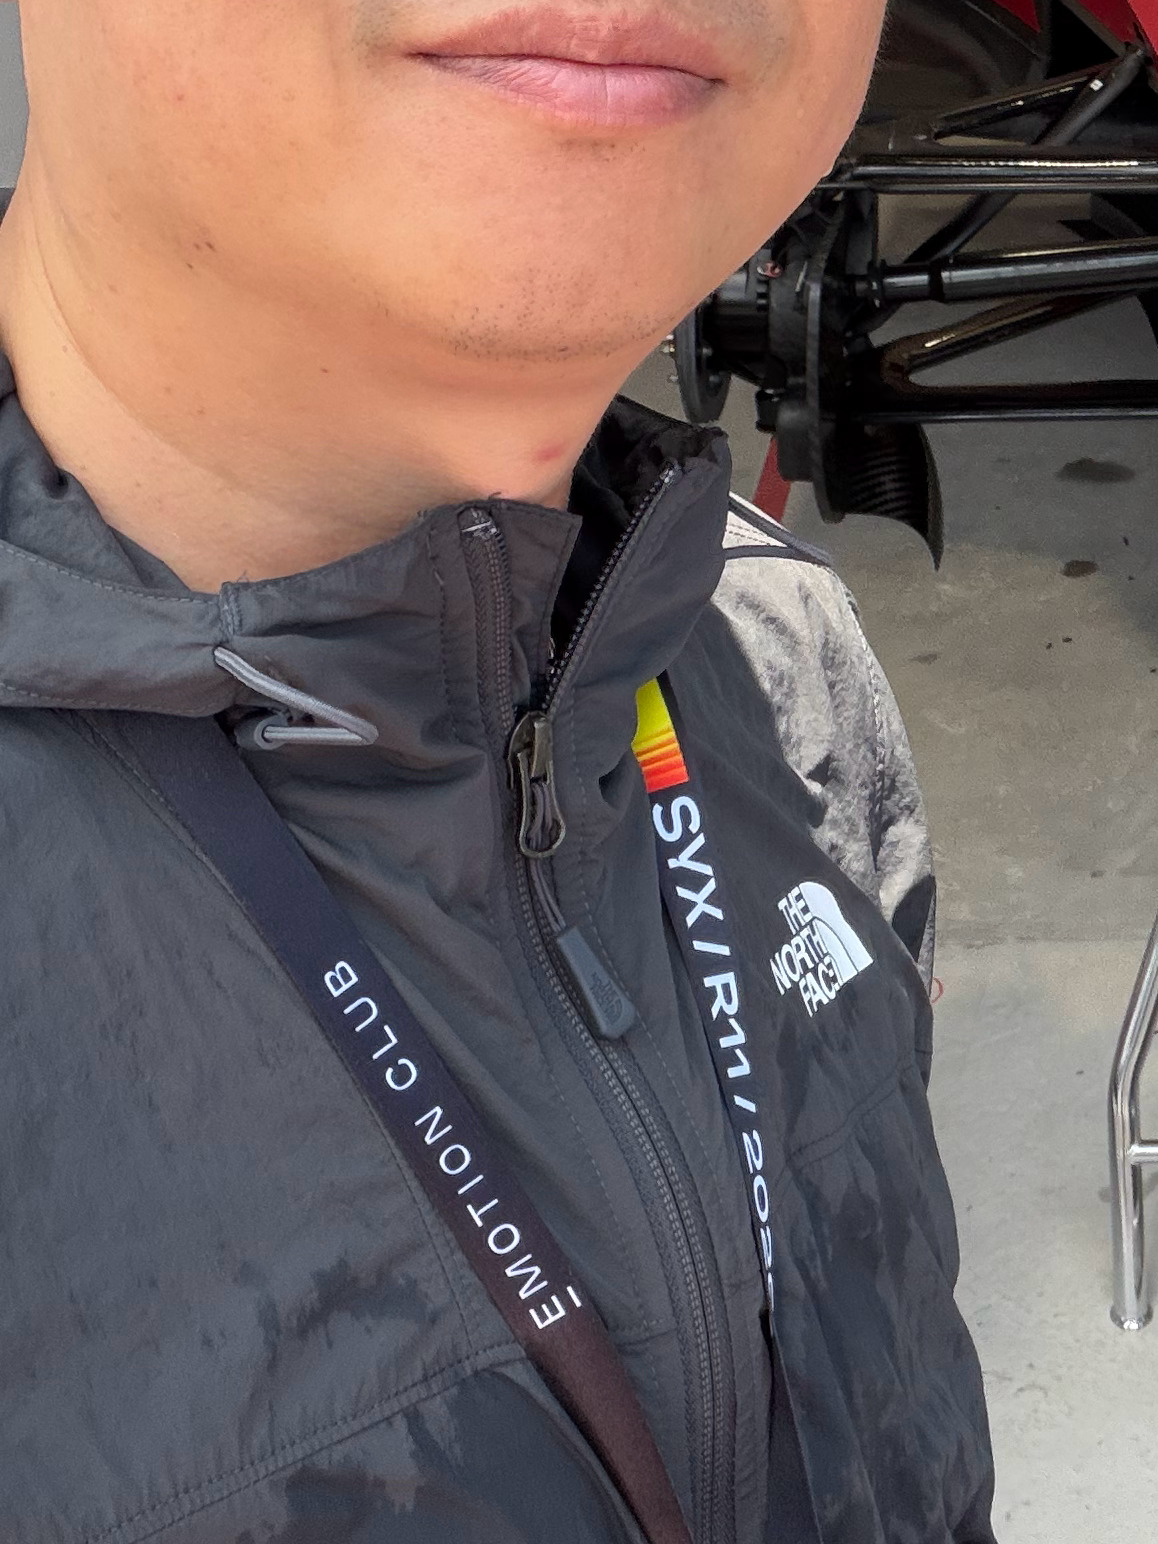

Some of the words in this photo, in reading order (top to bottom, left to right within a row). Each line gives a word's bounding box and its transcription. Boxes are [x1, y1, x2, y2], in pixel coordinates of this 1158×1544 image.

[652, 796, 724, 927] SYX
[692, 938, 732, 957] /
[778, 886, 814, 936] THE
[769, 919, 829, 996] NORTH
[798, 955, 843, 1018] FACE
[324, 960, 418, 1091] CLUB
[703, 971, 753, 1080] R11
[732, 1094, 757, 1114] /
[415, 1106, 581, 1329] EMOTION
